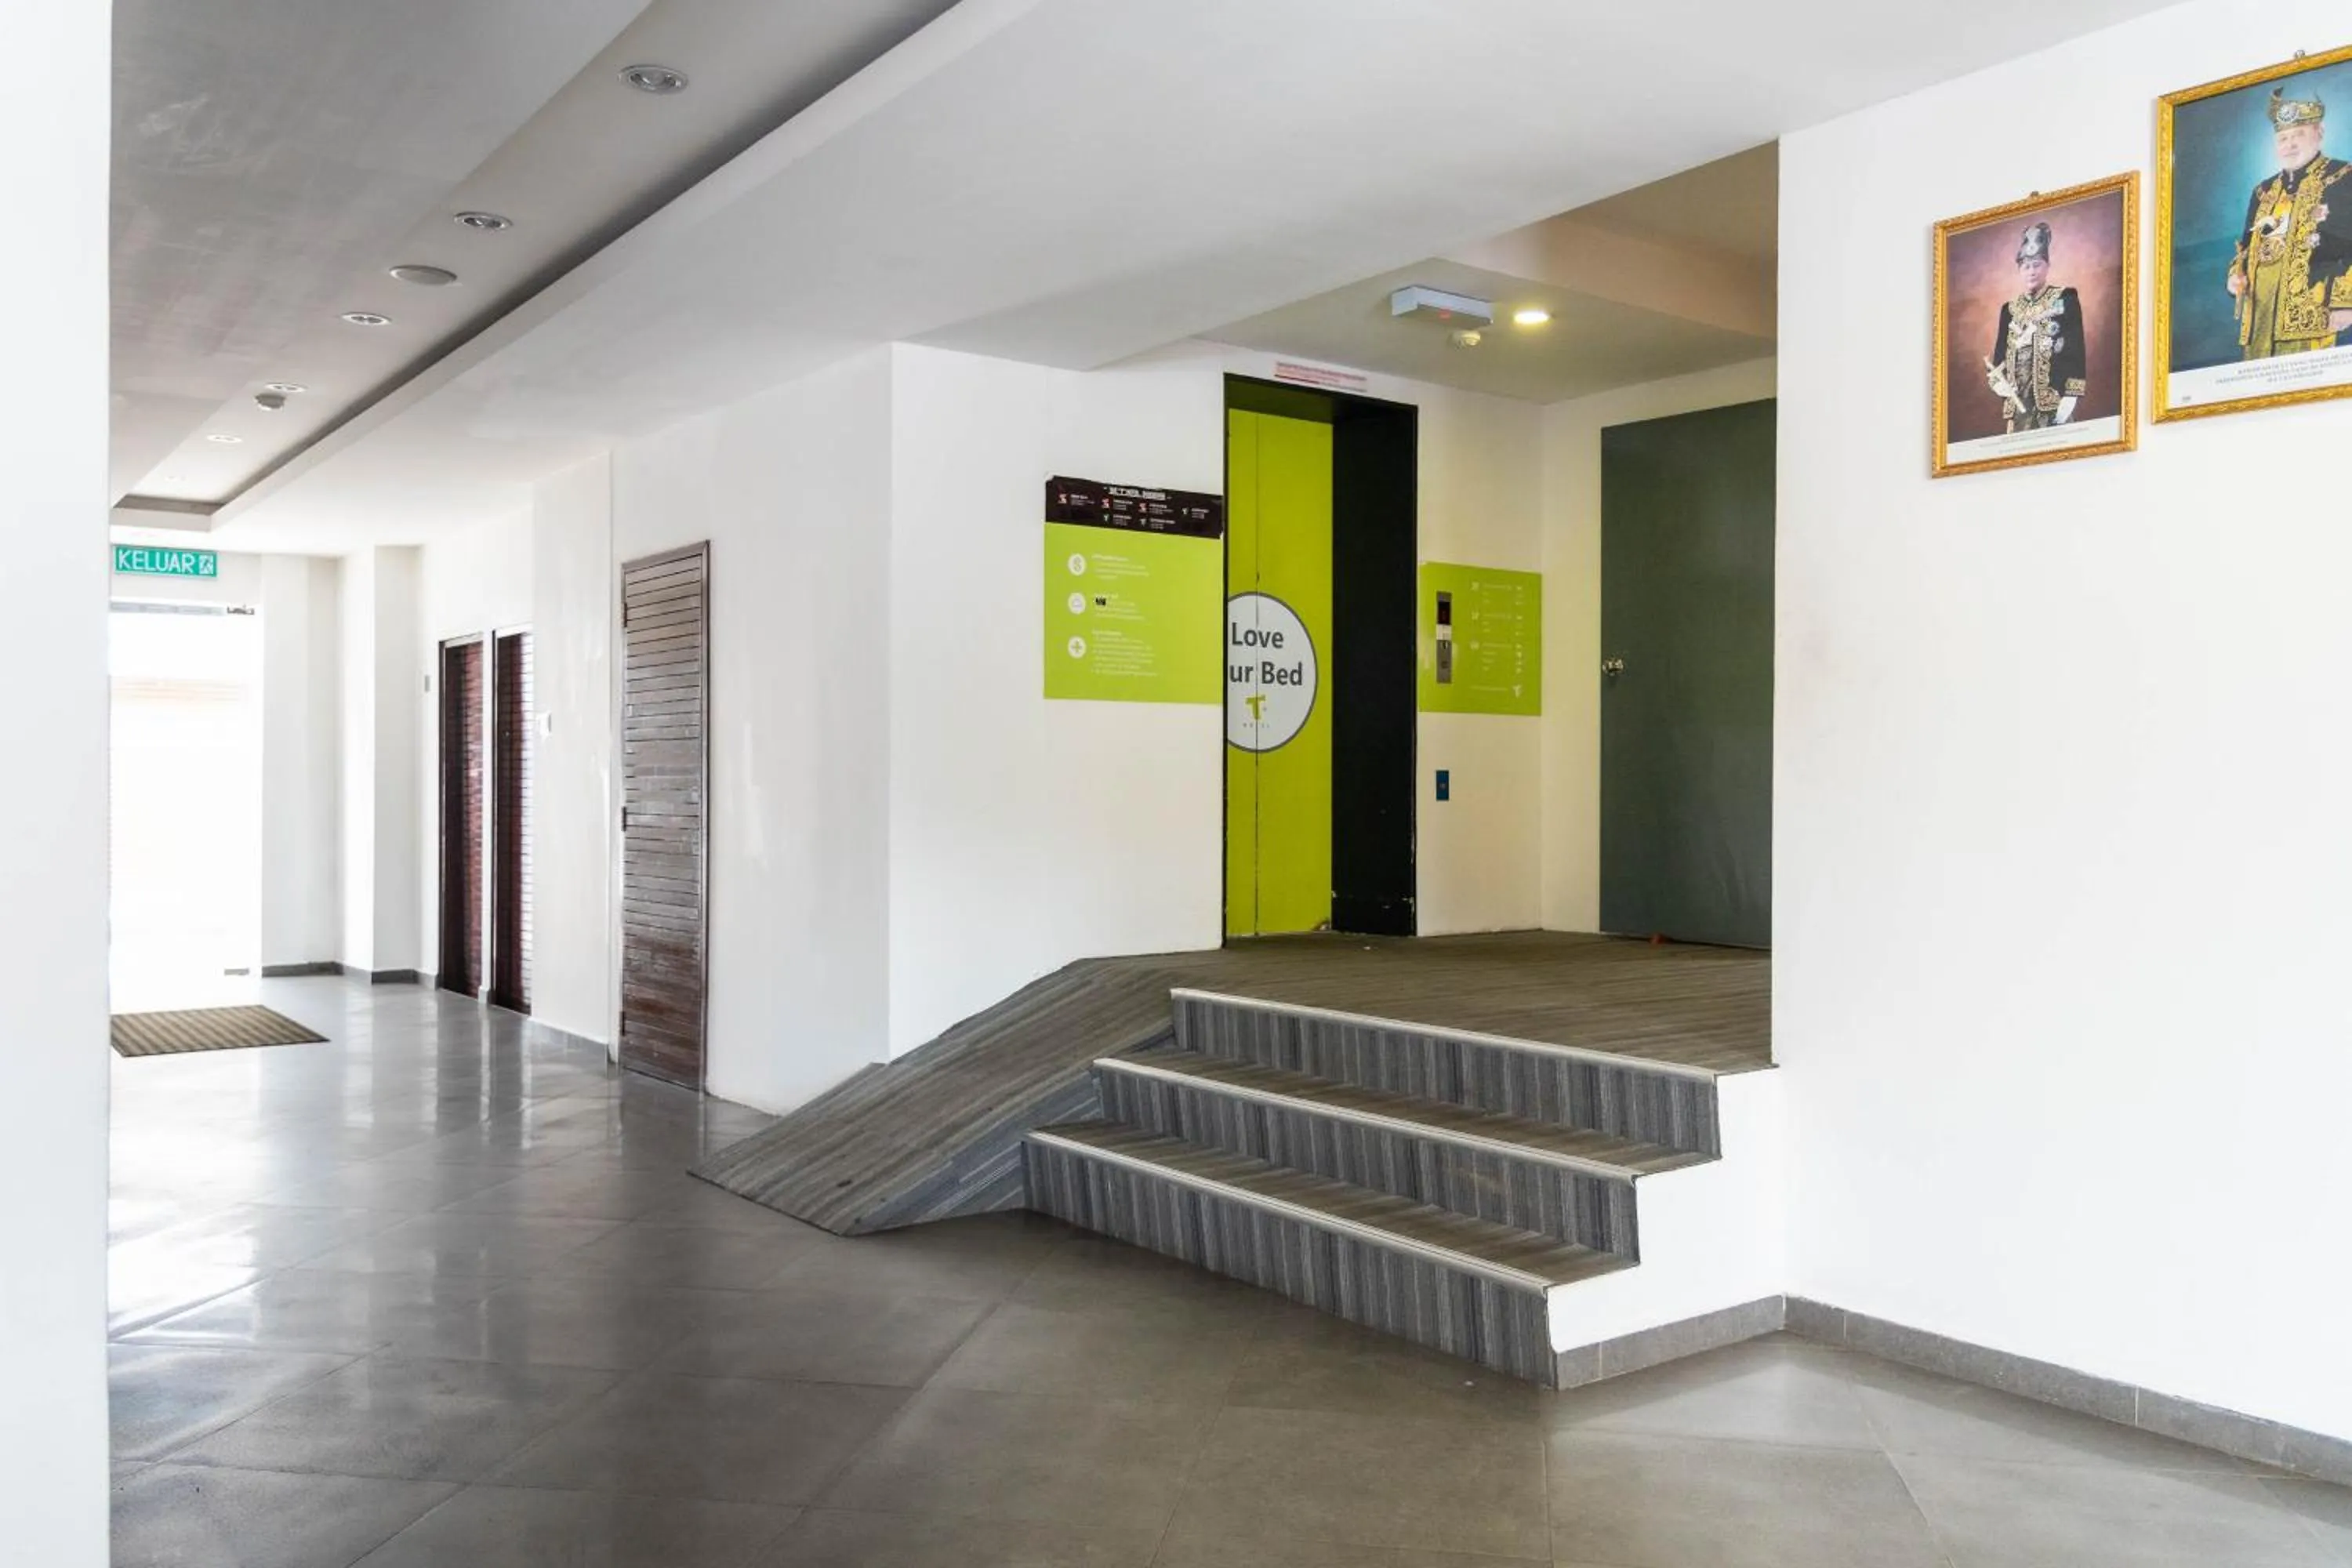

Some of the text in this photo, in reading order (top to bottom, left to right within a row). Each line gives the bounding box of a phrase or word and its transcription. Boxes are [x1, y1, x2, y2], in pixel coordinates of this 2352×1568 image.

[118, 550, 195, 573] KELUAR
[1232, 622, 1284, 648] Love
[1229, 661, 1302, 686] ur Bed
